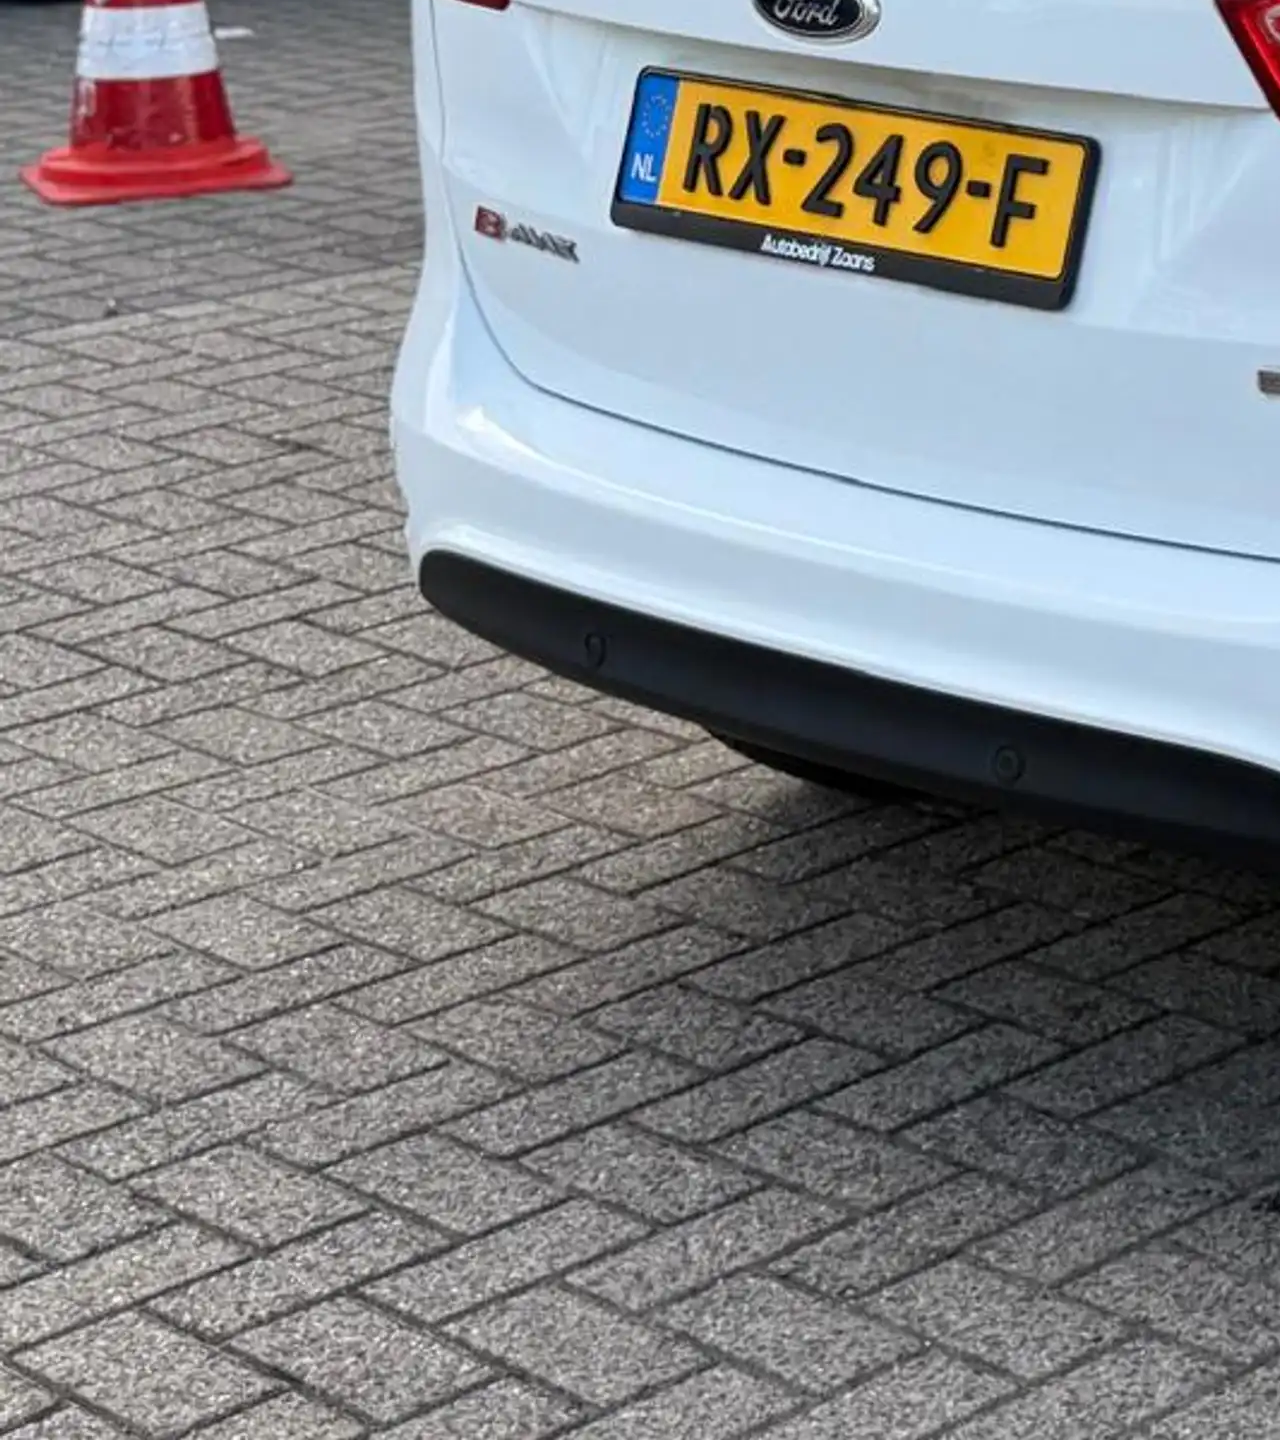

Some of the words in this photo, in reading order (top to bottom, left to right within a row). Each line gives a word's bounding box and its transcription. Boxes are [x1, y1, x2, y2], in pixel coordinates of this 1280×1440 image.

[631, 152, 656, 183] NL
[682, 102, 1051, 249] RX-249-F
[760, 233, 832, 266] Autobedrijf
[831, 246, 876, 272] Zaans
